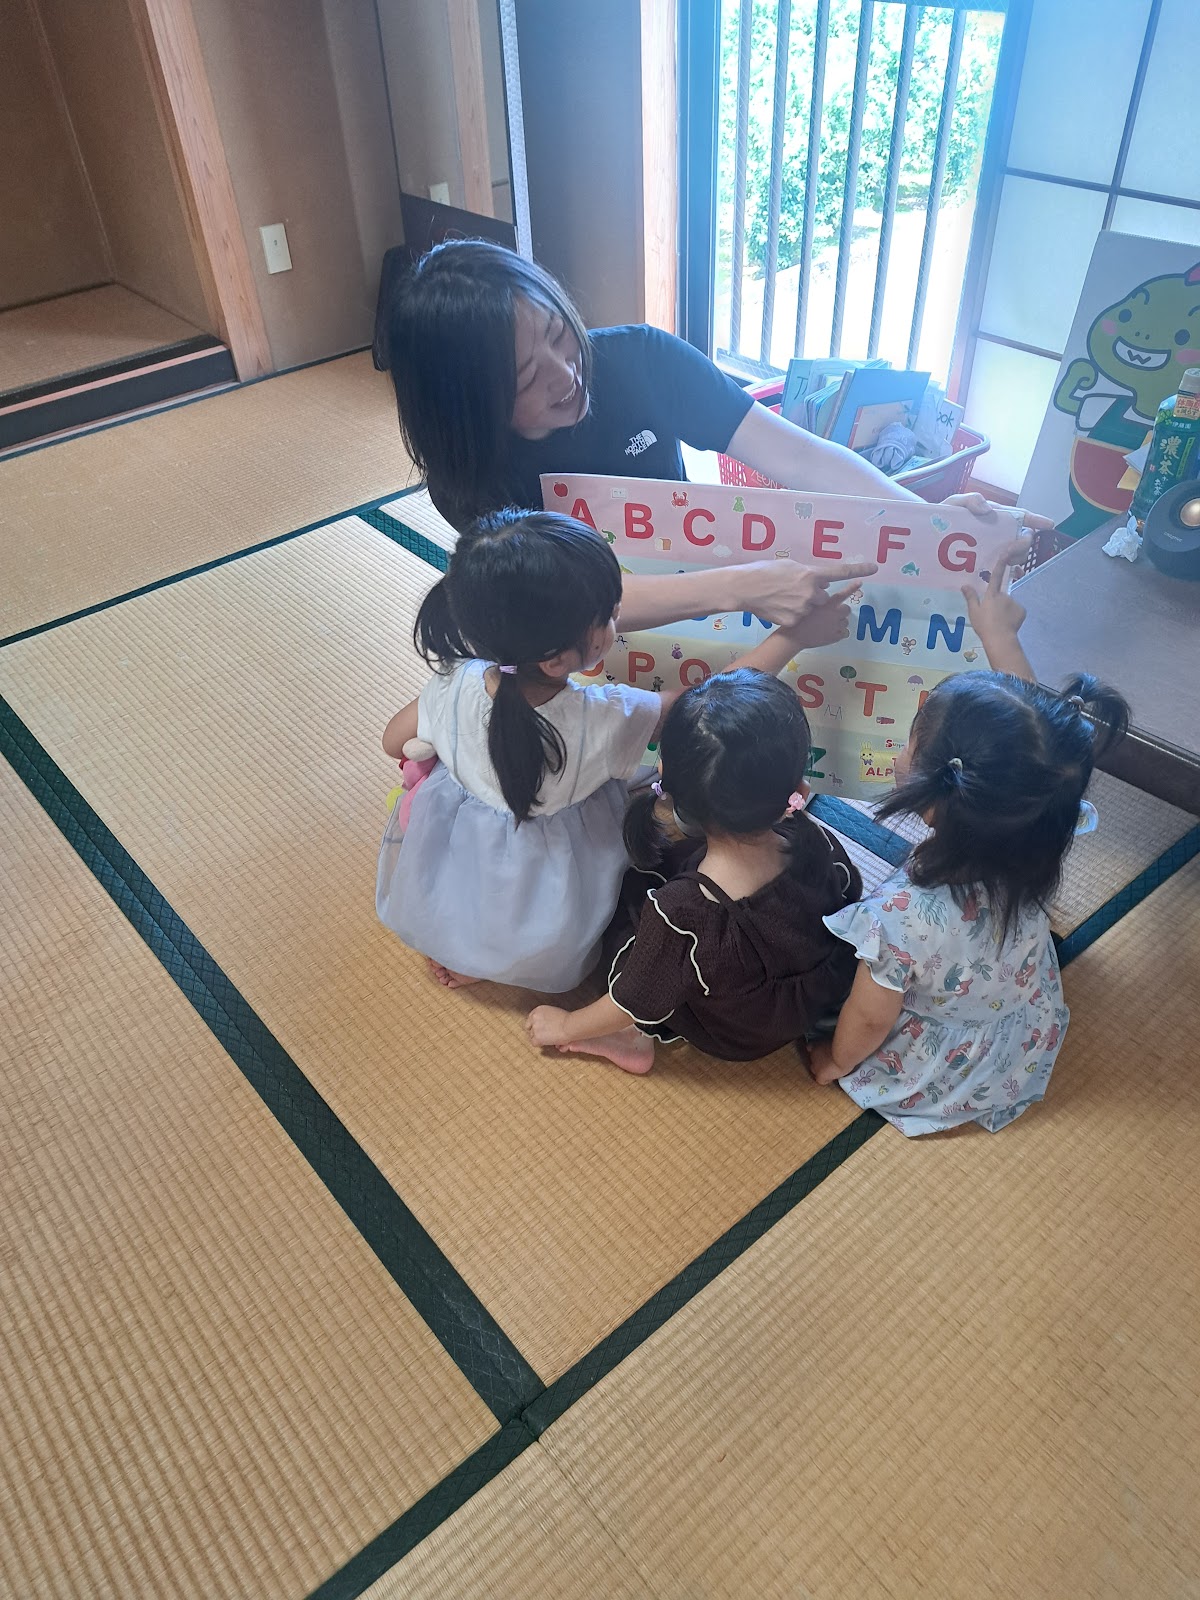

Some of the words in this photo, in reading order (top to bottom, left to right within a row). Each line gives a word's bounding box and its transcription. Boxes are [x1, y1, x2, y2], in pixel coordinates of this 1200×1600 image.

[625, 437, 647, 455] NORTH
[632, 444, 649, 457] FACE
[1158, 435, 1182, 476] 濃い茶
[570, 498, 598, 532] A
[624, 502, 655, 540] B
[683, 508, 716, 546] C
[741, 513, 776, 551] D
[812, 519, 845, 560] E
[876, 525, 911, 564] F
[937, 532, 977, 574] G
[856, 604, 902, 645] M
[926, 613, 966, 653] N
[628, 651, 655, 683] P
[679, 658, 711, 688] Q
[796, 673, 824, 709] S
[854, 681, 888, 717] T
[865, 766, 894, 777] ALP
